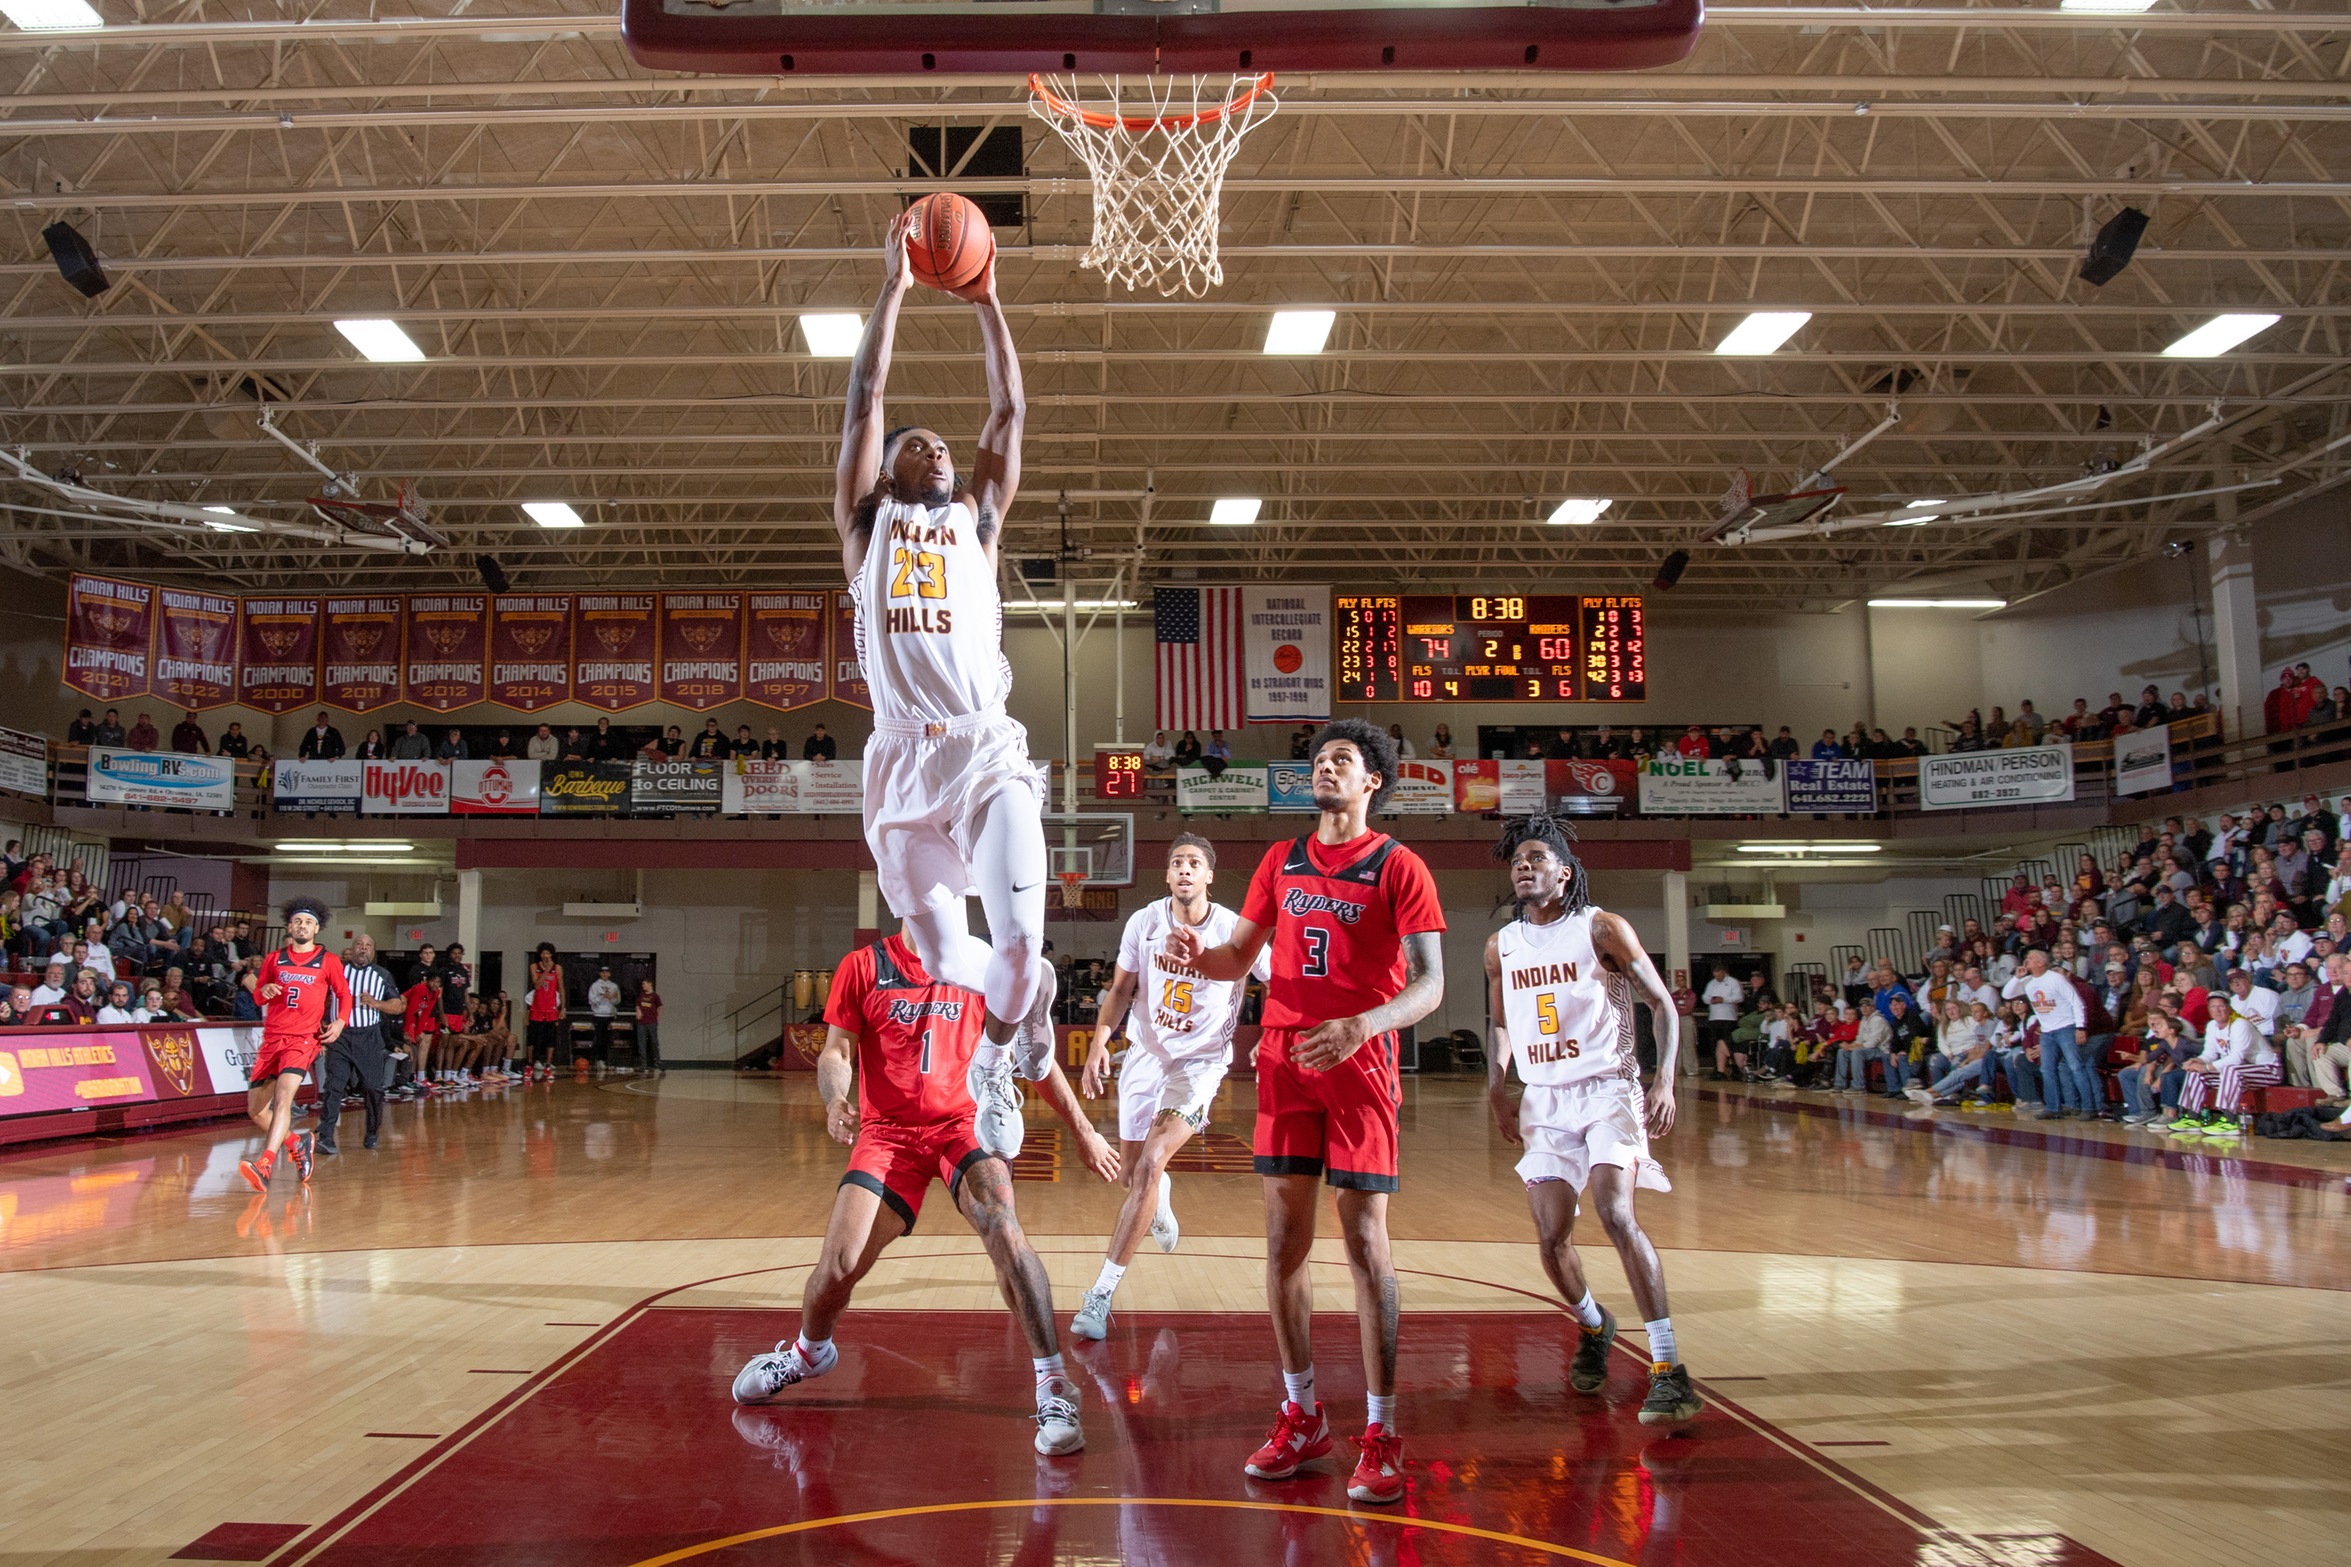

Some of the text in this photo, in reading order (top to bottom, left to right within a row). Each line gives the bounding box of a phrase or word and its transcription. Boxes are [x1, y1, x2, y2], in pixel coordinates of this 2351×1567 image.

[937, 195, 953, 251] PALDING
[891, 547, 948, 599] 23
[74, 578, 149, 603] INDIAN HILLS
[162, 592, 200, 610] INDIAN
[203, 598, 235, 614] HILLS
[246, 600, 317, 614] INDIAN HILLS
[328, 599, 400, 614] INDIAN HILLS
[411, 598, 484, 612] INDIAN HILLS
[496, 597, 569, 612] INDIAN HILLS
[579, 597, 653, 610] INDIAN HILLS
[665, 595, 739, 609] INDIAN HILLS
[752, 596, 823, 609] INDIAN HILLS
[1266, 598, 1307, 610] NATIONAL
[1338, 598, 1396, 608] PLY FL PTS
[1472, 598, 1523, 619] 8:38
[1621, 598, 1641, 608] PTS
[886, 606, 952, 634] HILLS
[1251, 613, 1322, 626] INTERCOLLEGIATE
[1351, 610, 1396, 623] 5 0 17
[1631, 610, 1641, 622] 3
[1271, 629, 1303, 640] RECORD
[1347, 625, 1396, 637] 15 1 2
[1478, 630, 1503, 638] PERIOD
[1594, 625, 1642, 637] 2 2 7
[1342, 640, 1396, 653] 22 2 17
[1420, 638, 1449, 658] 74
[1485, 640, 1497, 657] 2
[1540, 638, 1570, 660] 60
[1609, 640, 1619, 652] 2
[69, 646, 145, 677] CHAMPIONS
[1343, 655, 1397, 668] 23 3 8
[1611, 655, 1620, 667] 3
[1633, 655, 1642, 667] 2
[157, 658, 232, 687] CHAMPIONS
[243, 666, 315, 687] CHAMPIONS
[325, 665, 398, 686] CHAMPIONS
[409, 664, 482, 685] CHAMPIONS
[493, 664, 567, 685] CHAMPIONS
[577, 663, 651, 684] CHAMPIONS
[664, 662, 737, 683] CHAMPIONS
[750, 662, 822, 683] CHAMPIONS
[1343, 670, 1397, 683] 24 1 7
[1412, 665, 1432, 676] FLS
[1465, 665, 1520, 676] PLYR FOUL
[1552, 665, 1572, 676] FLS
[1587, 670, 1621, 682] 42 3
[81, 671, 129, 687] 2021
[1264, 677, 1301, 689] STRAIGHT
[1304, 678, 1324, 689] WINS
[167, 682, 220, 698] 2022
[252, 688, 304, 699] 2000
[341, 687, 381, 698] 2011
[422, 686, 468, 697] 2012
[505, 686, 553, 697] 2014
[591, 685, 637, 696] 2015
[677, 684, 724, 695] 2018
[763, 684, 809, 695] 1997
[1366, 685, 1375, 698] 0
[1413, 680, 1432, 697] 10
[1445, 681, 1458, 696] 4
[1528, 680, 1540, 697] 3
[1559, 680, 1572, 697] 6
[1611, 685, 1621, 697] 6
[101, 753, 158, 775] Bowling
[161, 759, 220, 780] RVs.com
[637, 762, 692, 775] FLOOR
[1109, 756, 1141, 770] 8:38
[1457, 763, 1479, 774] olé
[1650, 761, 1710, 777] NOEL
[1815, 762, 1869, 779] TEAM
[301, 775, 360, 783] FAMILY FIRST
[478, 779, 513, 793] OTTUMWA
[637, 778, 718, 790] to CEILING
[741, 776, 798, 785] OVERHEAD
[1106, 771, 1135, 794] 27
[1790, 780, 1870, 791] Real Estate
[1931, 770, 2062, 789] HEATING & AIR CONDITIONING
[545, 774, 626, 802] Barbecue
[743, 785, 798, 798] DOORS
[1791, 794, 1871, 803] 641.682.2221
[1282, 888, 1366, 925] RAIDERS
[1302, 926, 1330, 978] 3
[279, 970, 317, 985] RAIDERS
[1511, 962, 1578, 990] INDIAN
[287, 986, 300, 1009] 2
[1163, 978, 1194, 1015] 15
[887, 999, 963, 1024] RAIDERS
[1536, 992, 1560, 1036] 5
[1154, 1009, 1193, 1033] HILLS
[920, 1029, 932, 1074] 1
[1527, 1039, 1580, 1065] HILLS
